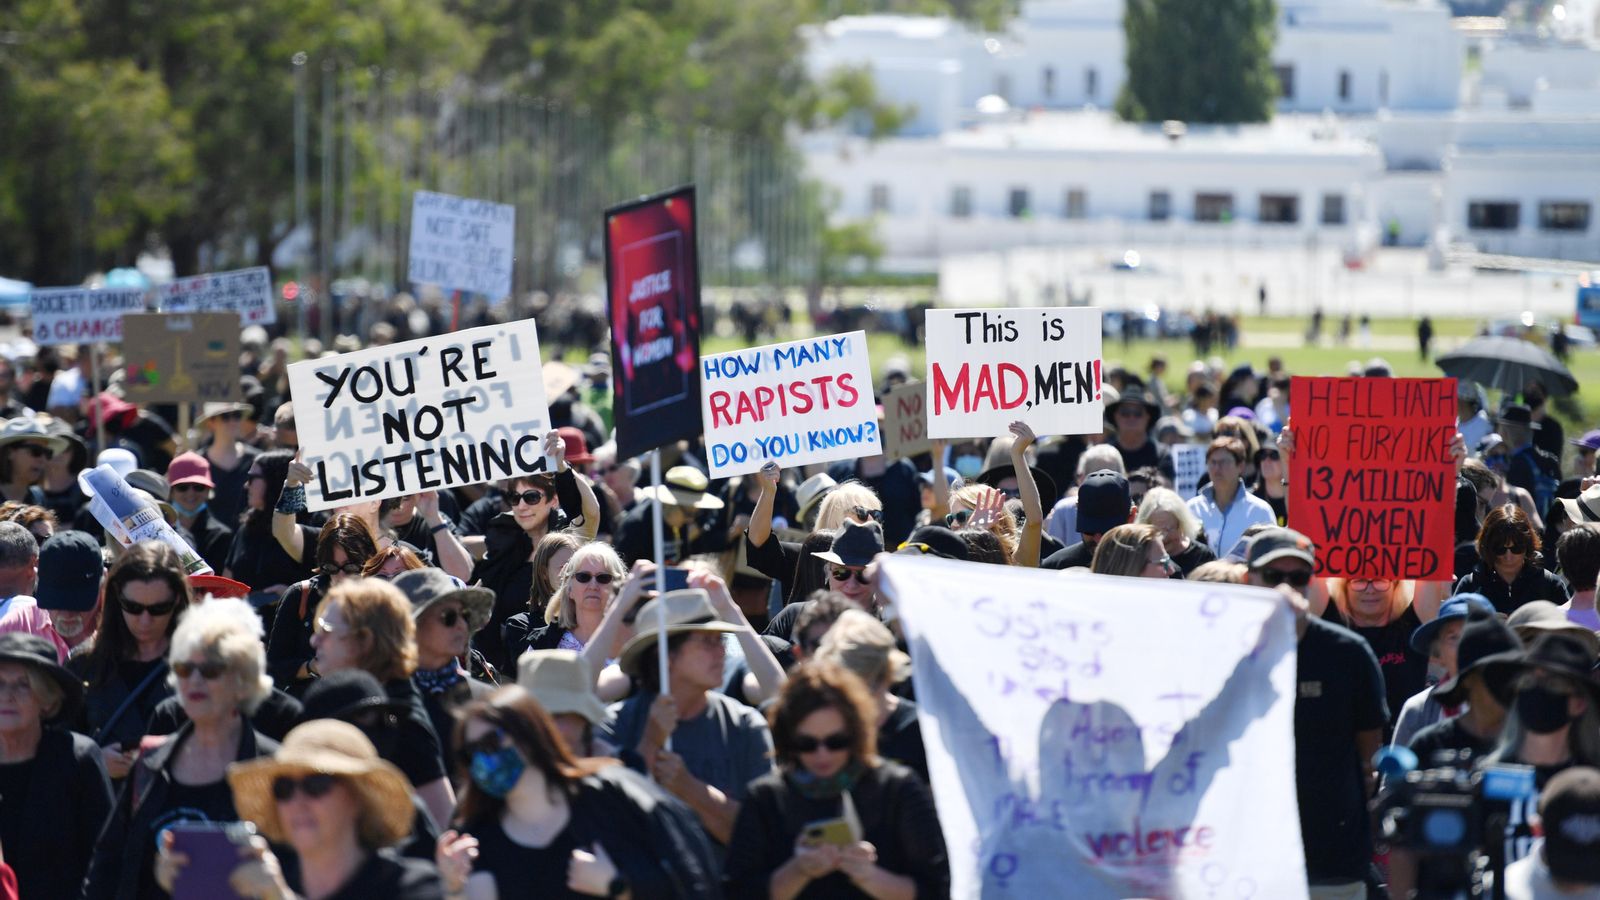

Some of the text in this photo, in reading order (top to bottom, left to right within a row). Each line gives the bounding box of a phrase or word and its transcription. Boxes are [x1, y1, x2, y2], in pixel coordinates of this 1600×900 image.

[629, 268, 673, 304] JUSTICE
[638, 305, 665, 333] FOR
[954, 312, 1065, 344] This is
[633, 335, 675, 368] WOMEN
[704, 337, 847, 380] HOW MANY
[315, 340, 497, 409] YOU'RE
[709, 372, 859, 430] RAPISTS
[896, 393, 922, 419] NO
[1308, 380, 1458, 418] HELL HATH
[382, 396, 477, 444] NOT
[900, 418, 923, 443] NO
[711, 421, 876, 468] DO YOU KNOW?
[1292, 424, 1331, 461] NO
[1346, 423, 1406, 462] FURY
[317, 434, 548, 502] LISTENING
[1306, 466, 1445, 503] 13 MILLION
[1319, 504, 1426, 546] WOMEN
[1313, 543, 1439, 579] SCORNED
[1083, 814, 1217, 860] violence
